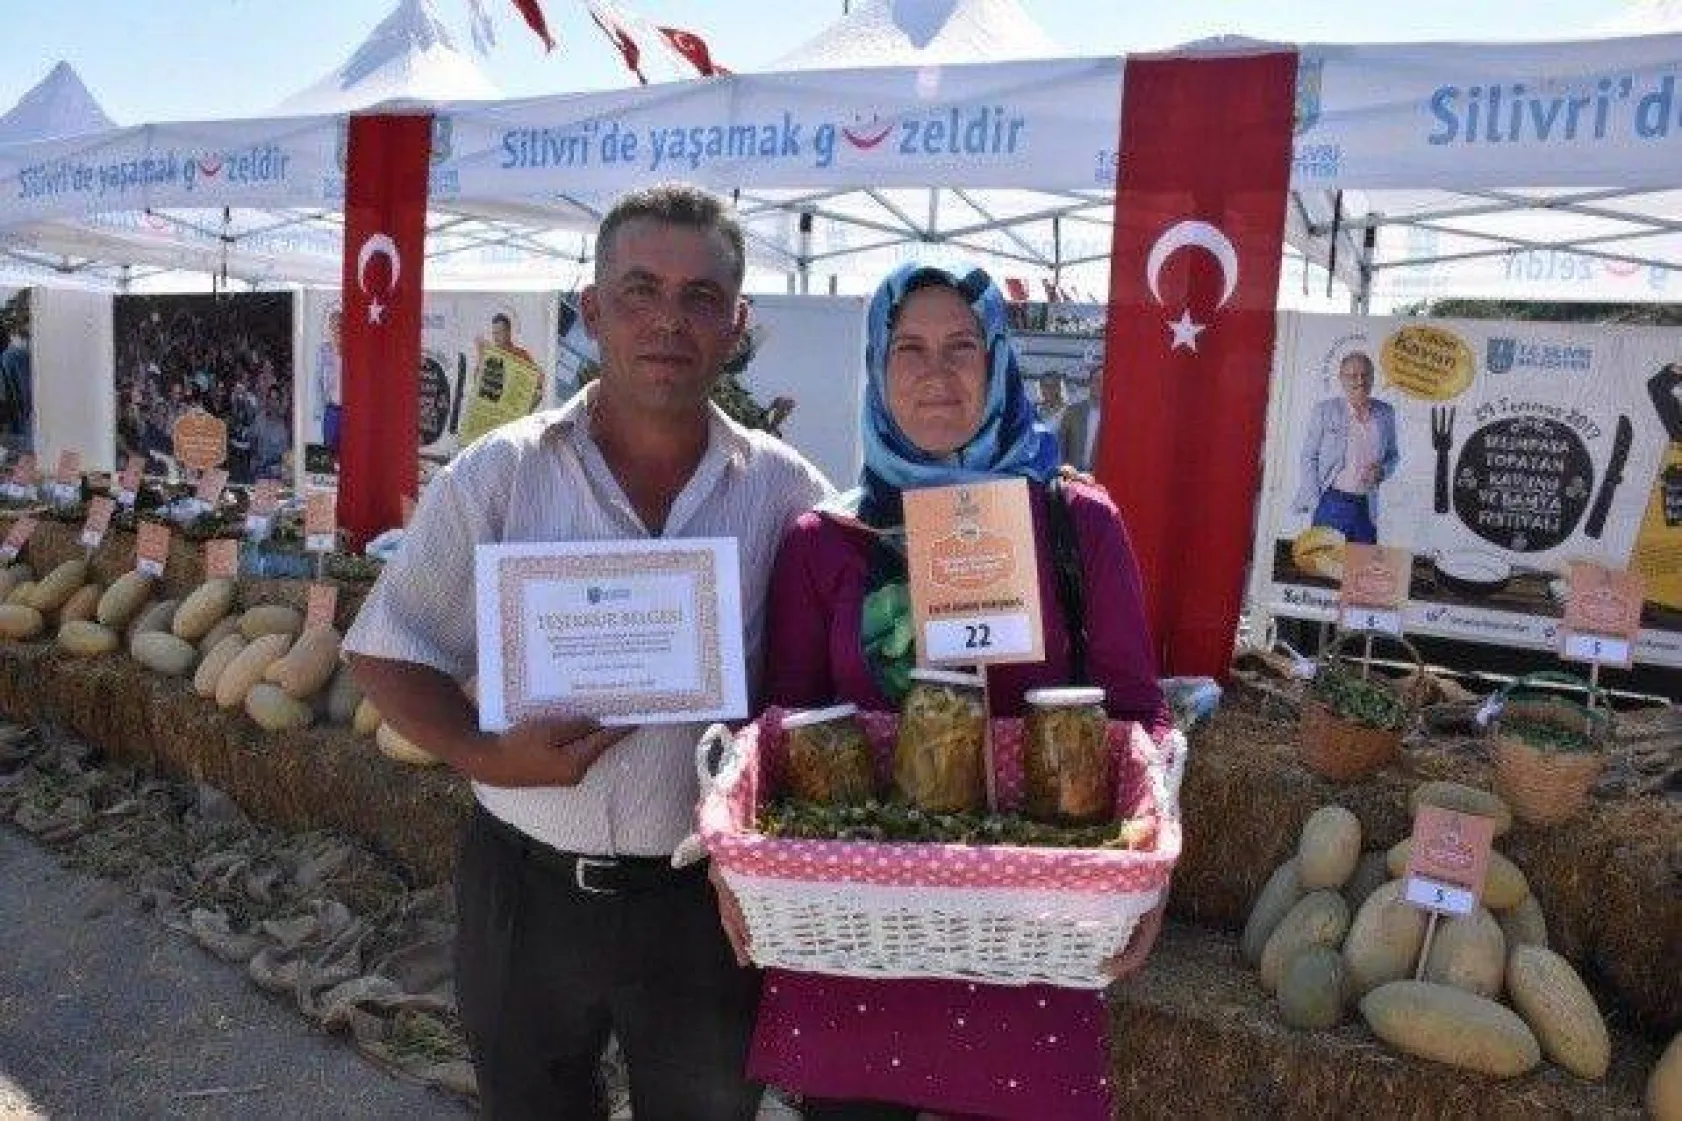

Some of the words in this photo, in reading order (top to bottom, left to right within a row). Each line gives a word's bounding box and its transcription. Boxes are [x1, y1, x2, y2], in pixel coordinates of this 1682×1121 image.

[1429, 75, 1682, 145] Silivri'd
[501, 123, 636, 169] Silivri'de
[650, 112, 802, 172] yaşamak
[99, 153, 177, 197] yaşamak
[965, 624, 992, 648] 22
